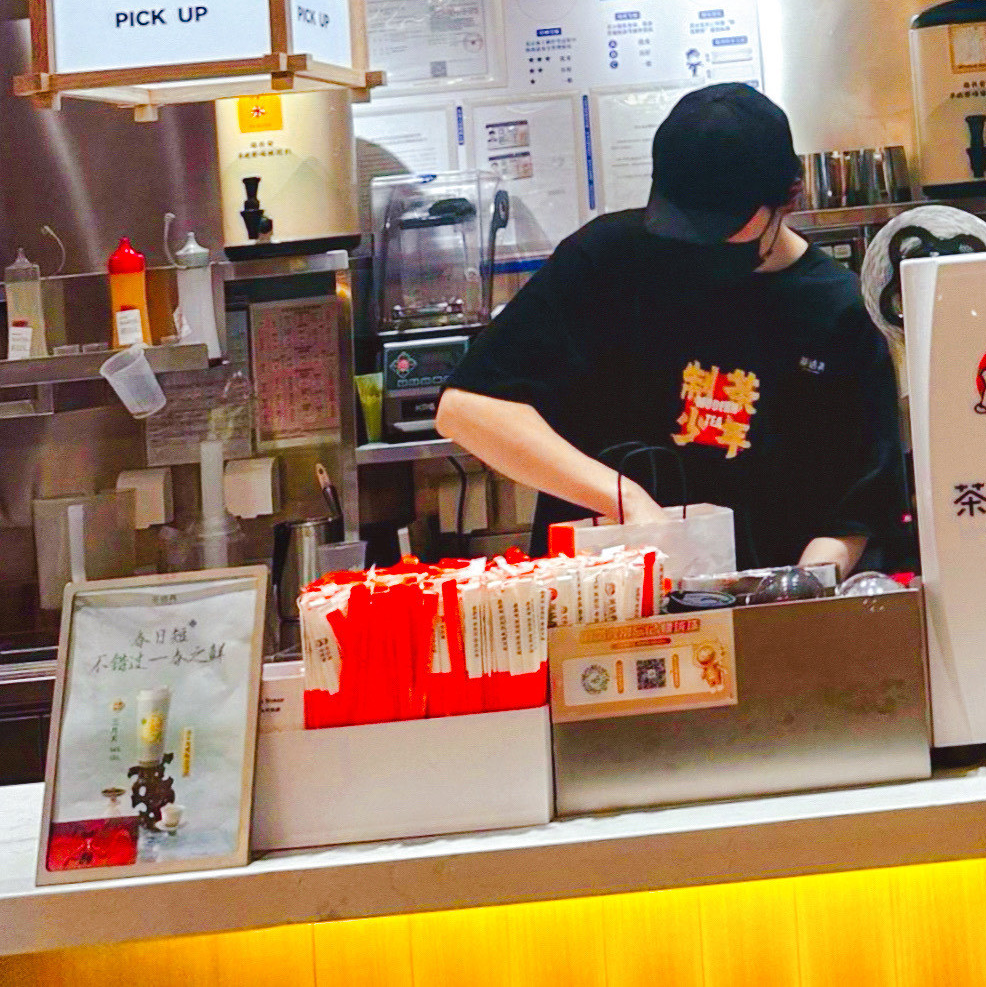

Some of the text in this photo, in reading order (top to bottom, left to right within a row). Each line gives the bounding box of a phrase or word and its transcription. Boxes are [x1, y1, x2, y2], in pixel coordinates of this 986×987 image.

[115, 6, 208, 28] PICK UP
[297, 5, 331, 29] PICK UP
